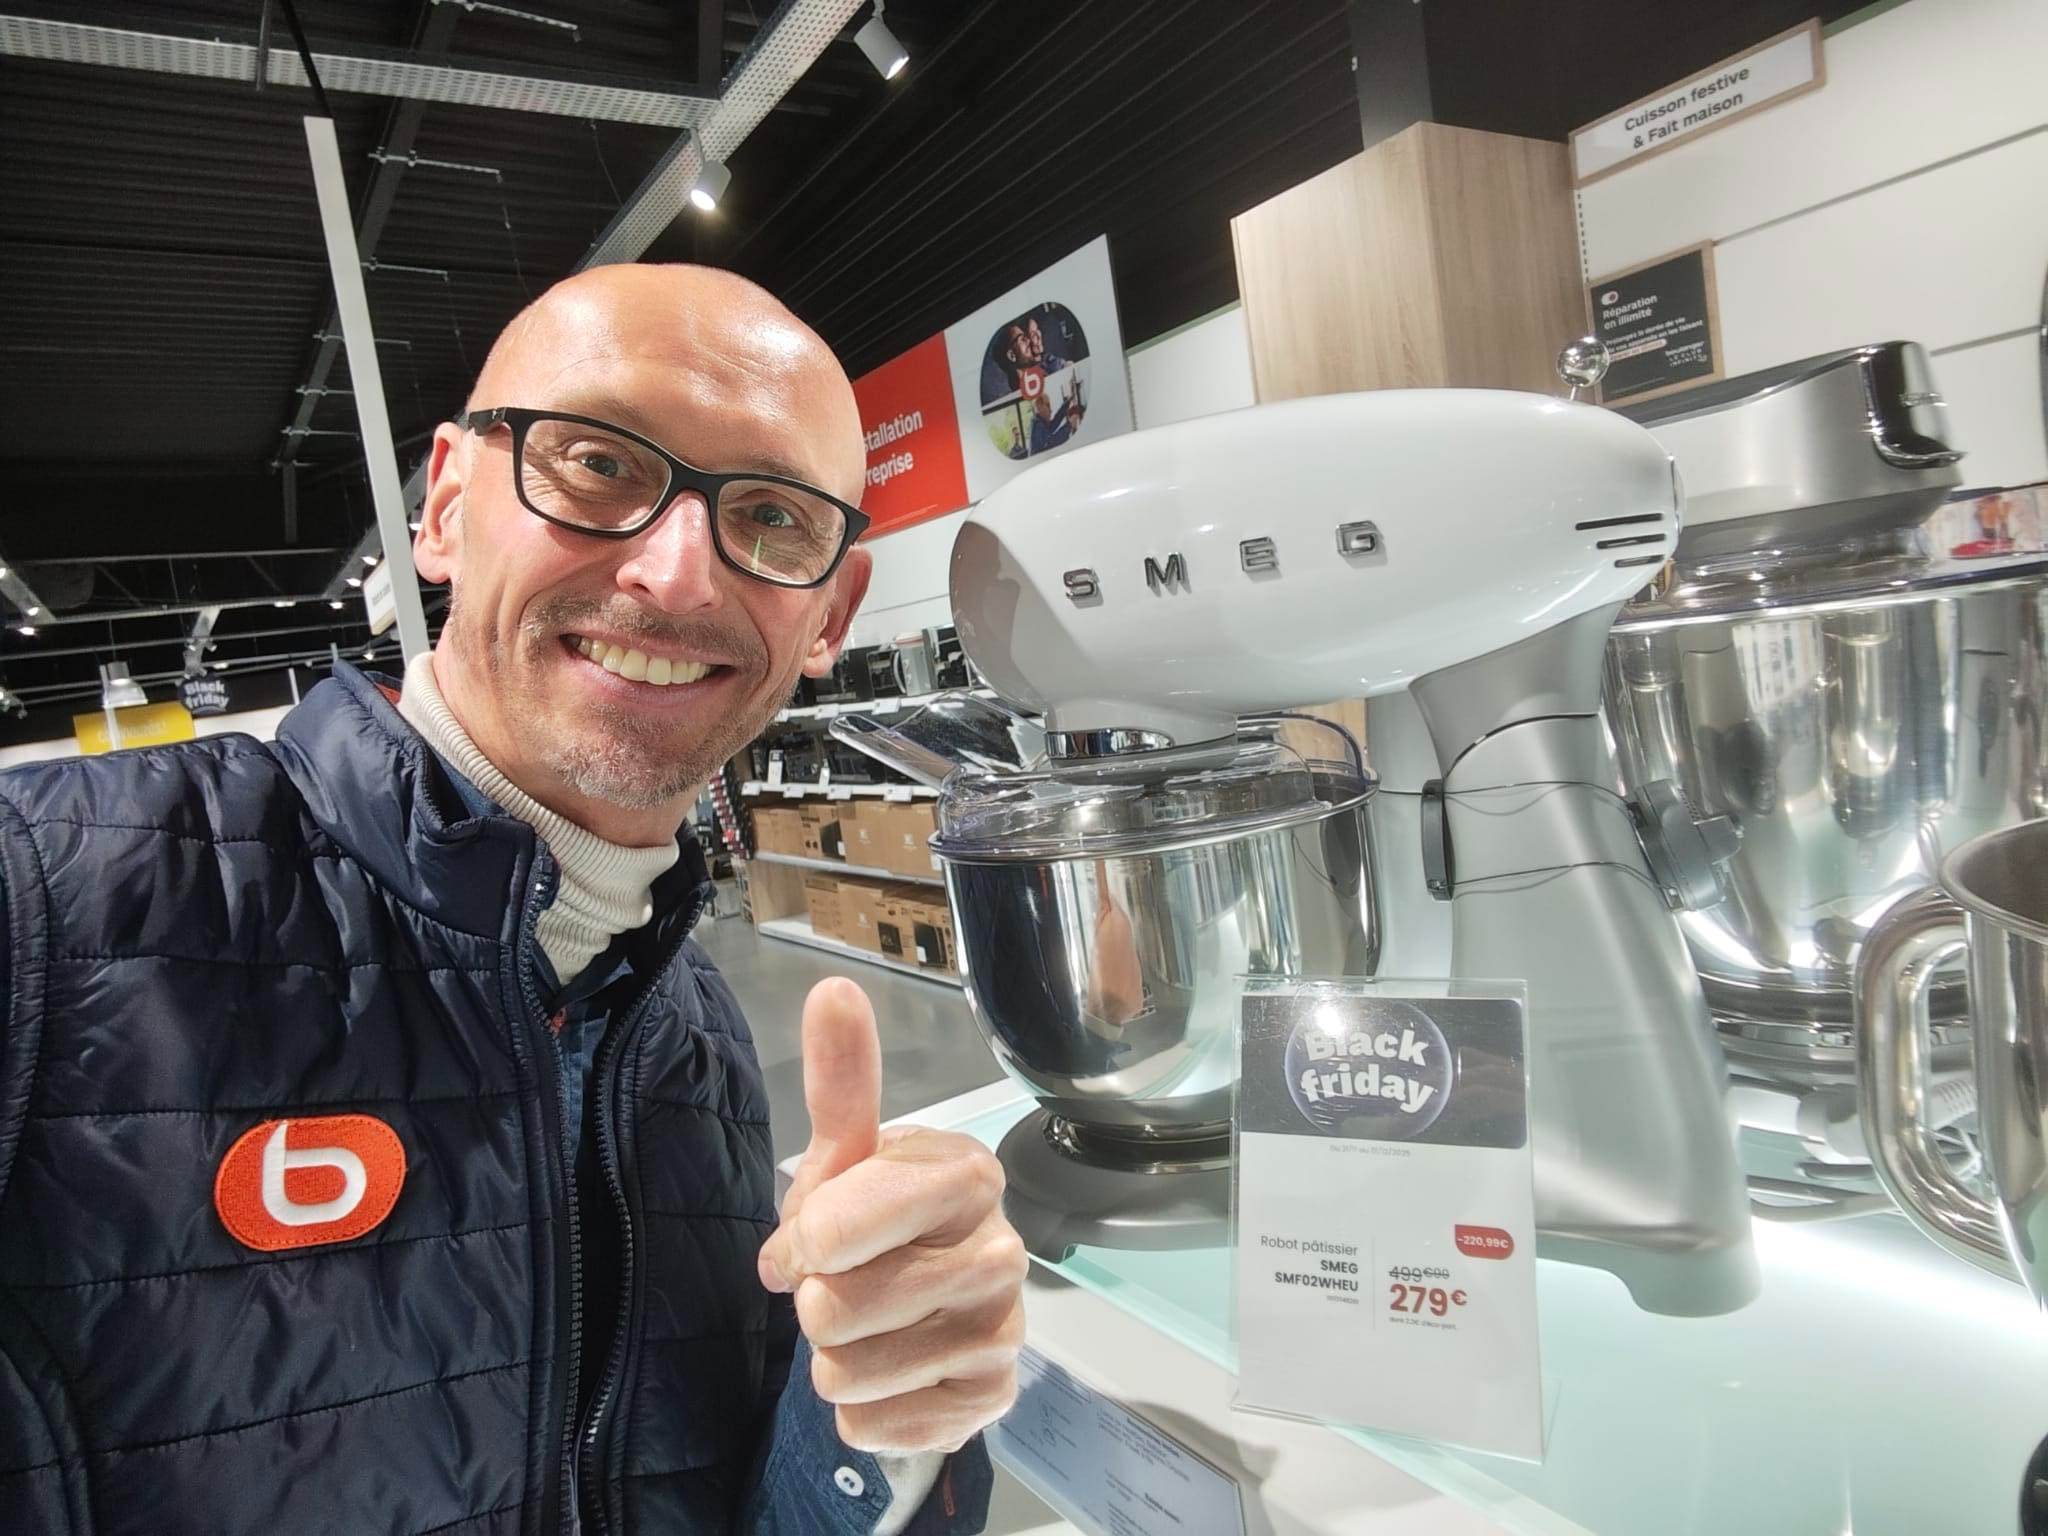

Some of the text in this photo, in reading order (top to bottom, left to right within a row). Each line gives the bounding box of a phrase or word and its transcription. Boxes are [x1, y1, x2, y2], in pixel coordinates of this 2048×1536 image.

[1625, 68, 1750, 131] Cuisson festive
[1633, 93, 1743, 149] & Fait maison
[1602, 295, 1658, 320] Réparation
[1603, 307, 1652, 330] en illimité
[864, 411, 923, 453] stallation
[185, 680, 225, 695] Black
[186, 693, 229, 709] friday
[1304, 1028, 1429, 1067] Black
[1301, 1063, 1434, 1113] friday
[262, 1120, 367, 1227] b
[1261, 1235, 1358, 1257] Robot pâtissier
[1457, 1236, 1509, 1249] -220,99€
[1320, 1260, 1358, 1274] SMEG
[1274, 1272, 1358, 1292] SMF02WHEU
[1389, 1284, 1467, 1317] 279€
